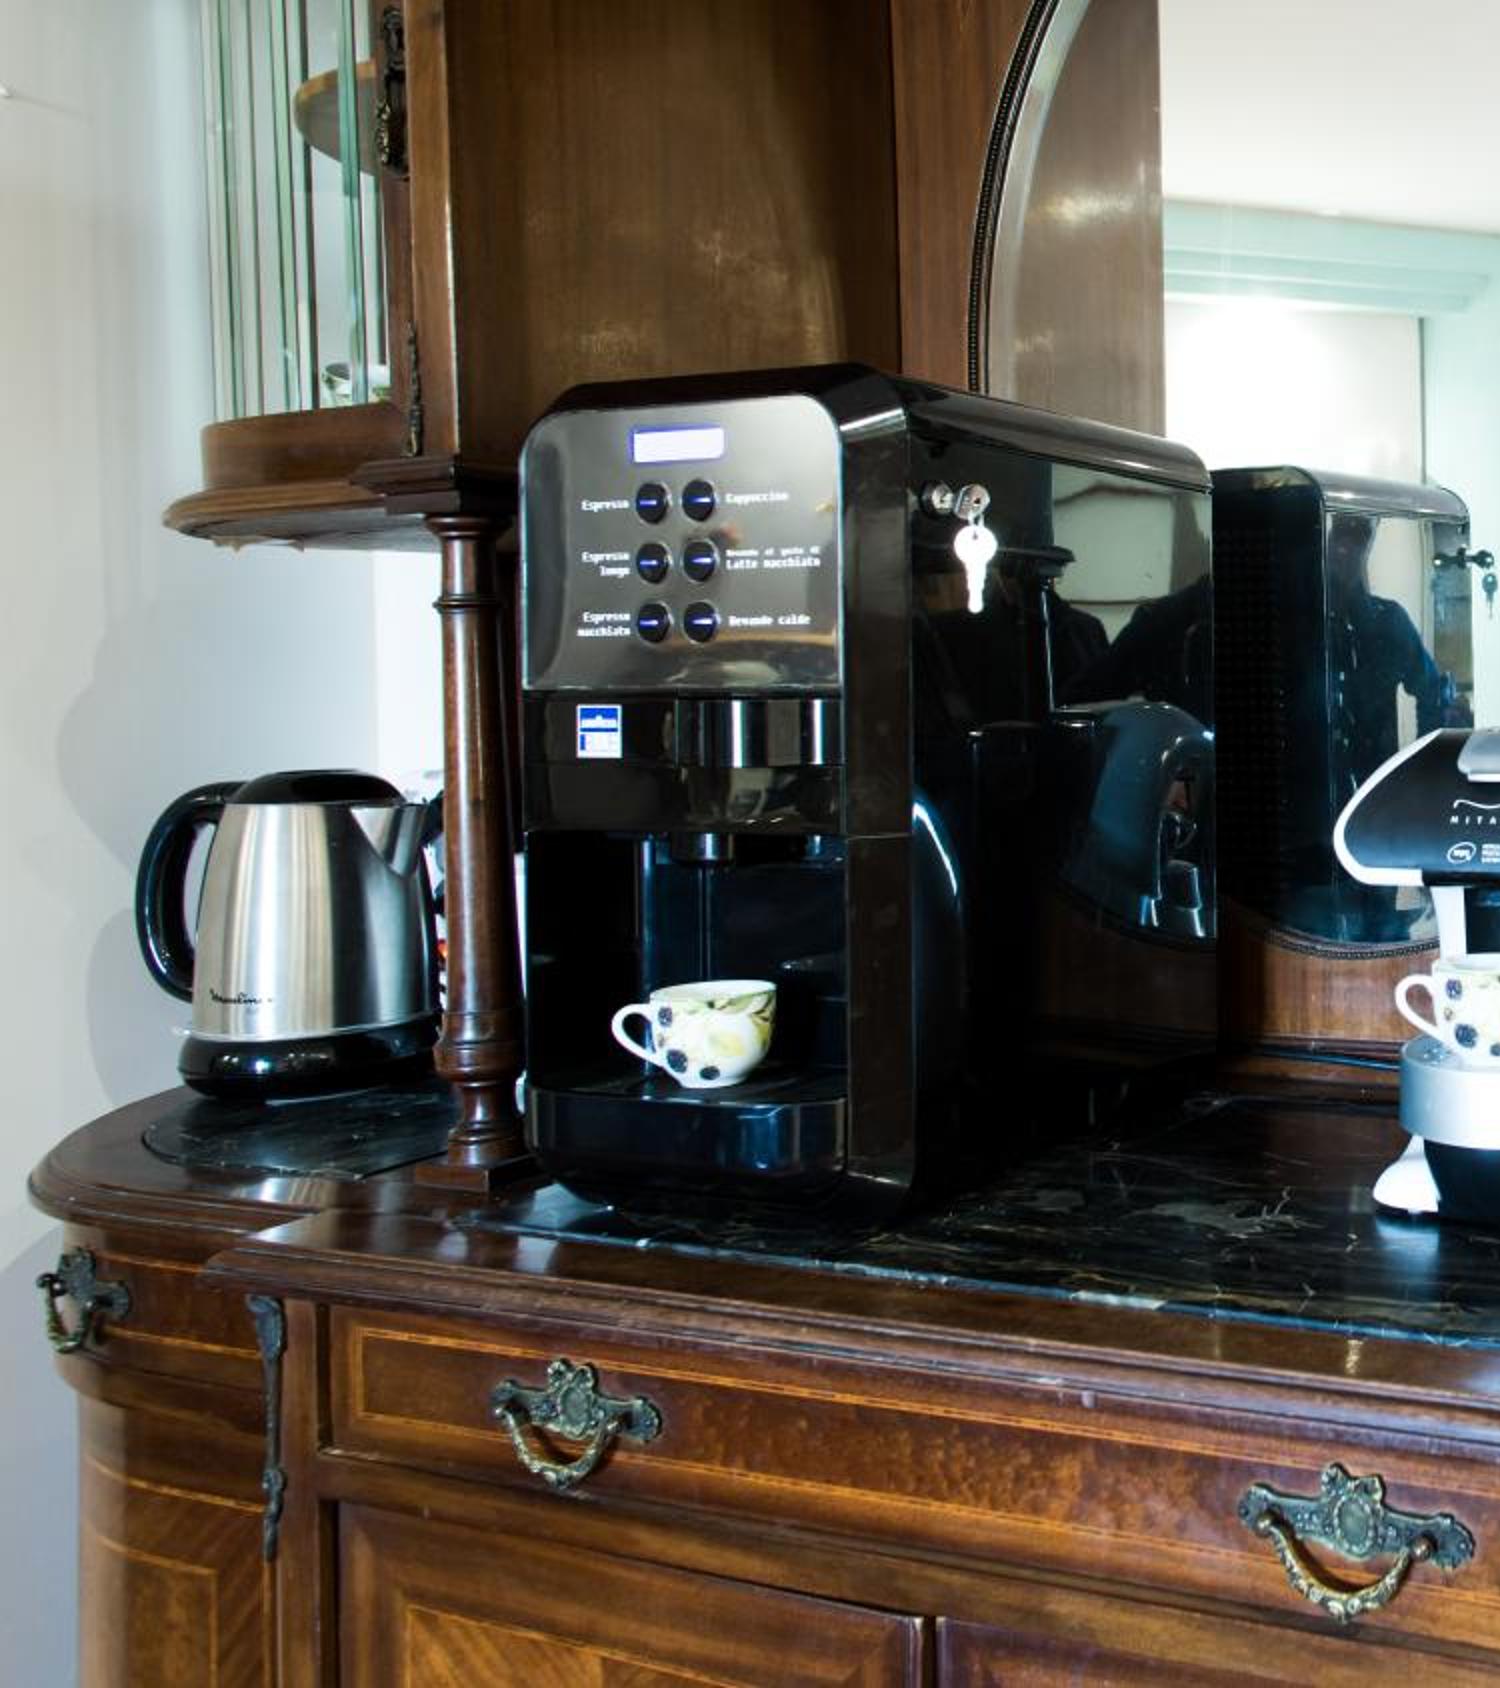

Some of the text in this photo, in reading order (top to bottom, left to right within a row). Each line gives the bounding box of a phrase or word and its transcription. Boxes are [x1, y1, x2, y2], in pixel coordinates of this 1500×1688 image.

[725, 492, 788, 505] Cappuccino
[581, 499, 629, 512] Espresso
[581, 551, 630, 565] Espresso
[726, 556, 821, 570] Latte macchiato
[582, 611, 631, 624] Espresso
